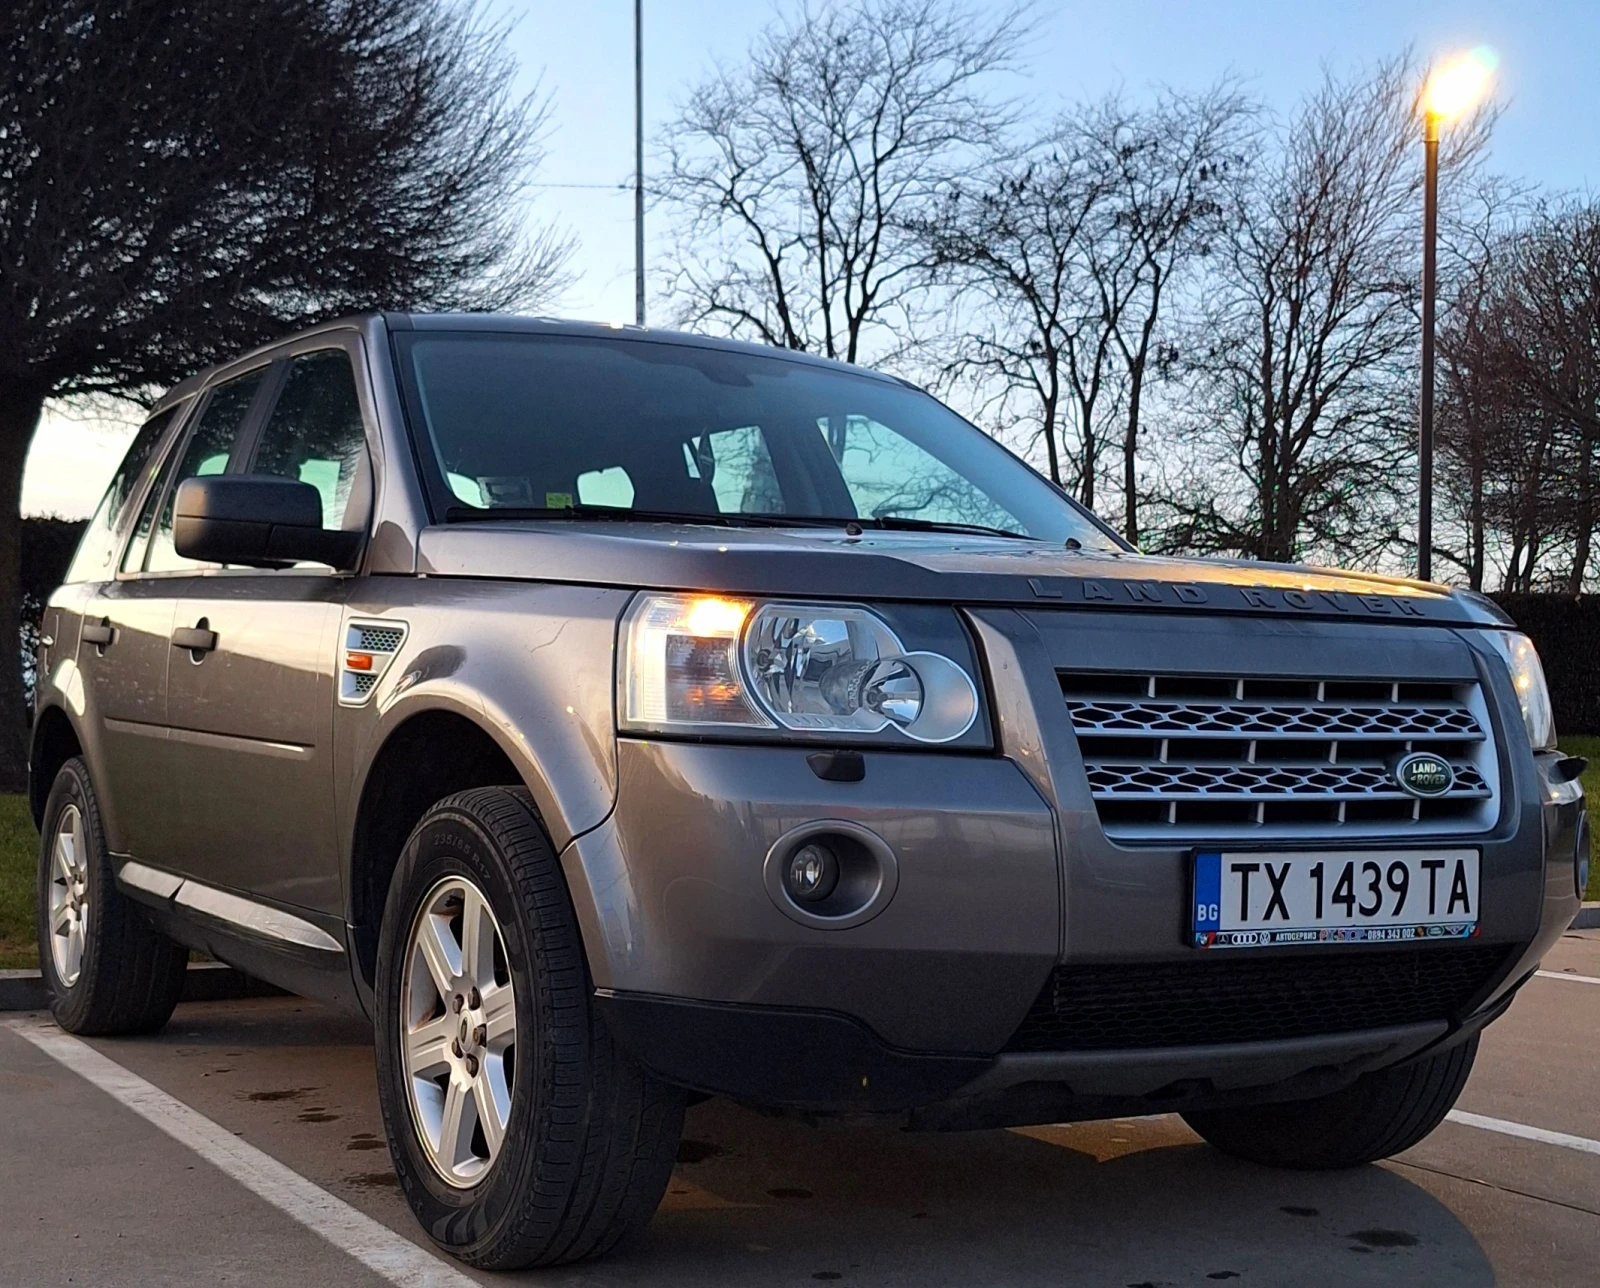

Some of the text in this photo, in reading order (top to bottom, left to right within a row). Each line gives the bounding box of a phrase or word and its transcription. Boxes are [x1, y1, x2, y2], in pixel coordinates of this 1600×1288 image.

[1027, 578, 1425, 617] LAND ROVER
[1412, 763, 1437, 774] LAND
[1416, 774, 1446, 785] ROVER
[1231, 859, 1470, 921] TX 1439 TA
[1197, 904, 1218, 921] BG
[1275, 931, 1317, 942] АВТОСЕРВИЗ
[1387, 929, 1400, 939] 343
[1402, 928, 1415, 939] 002
